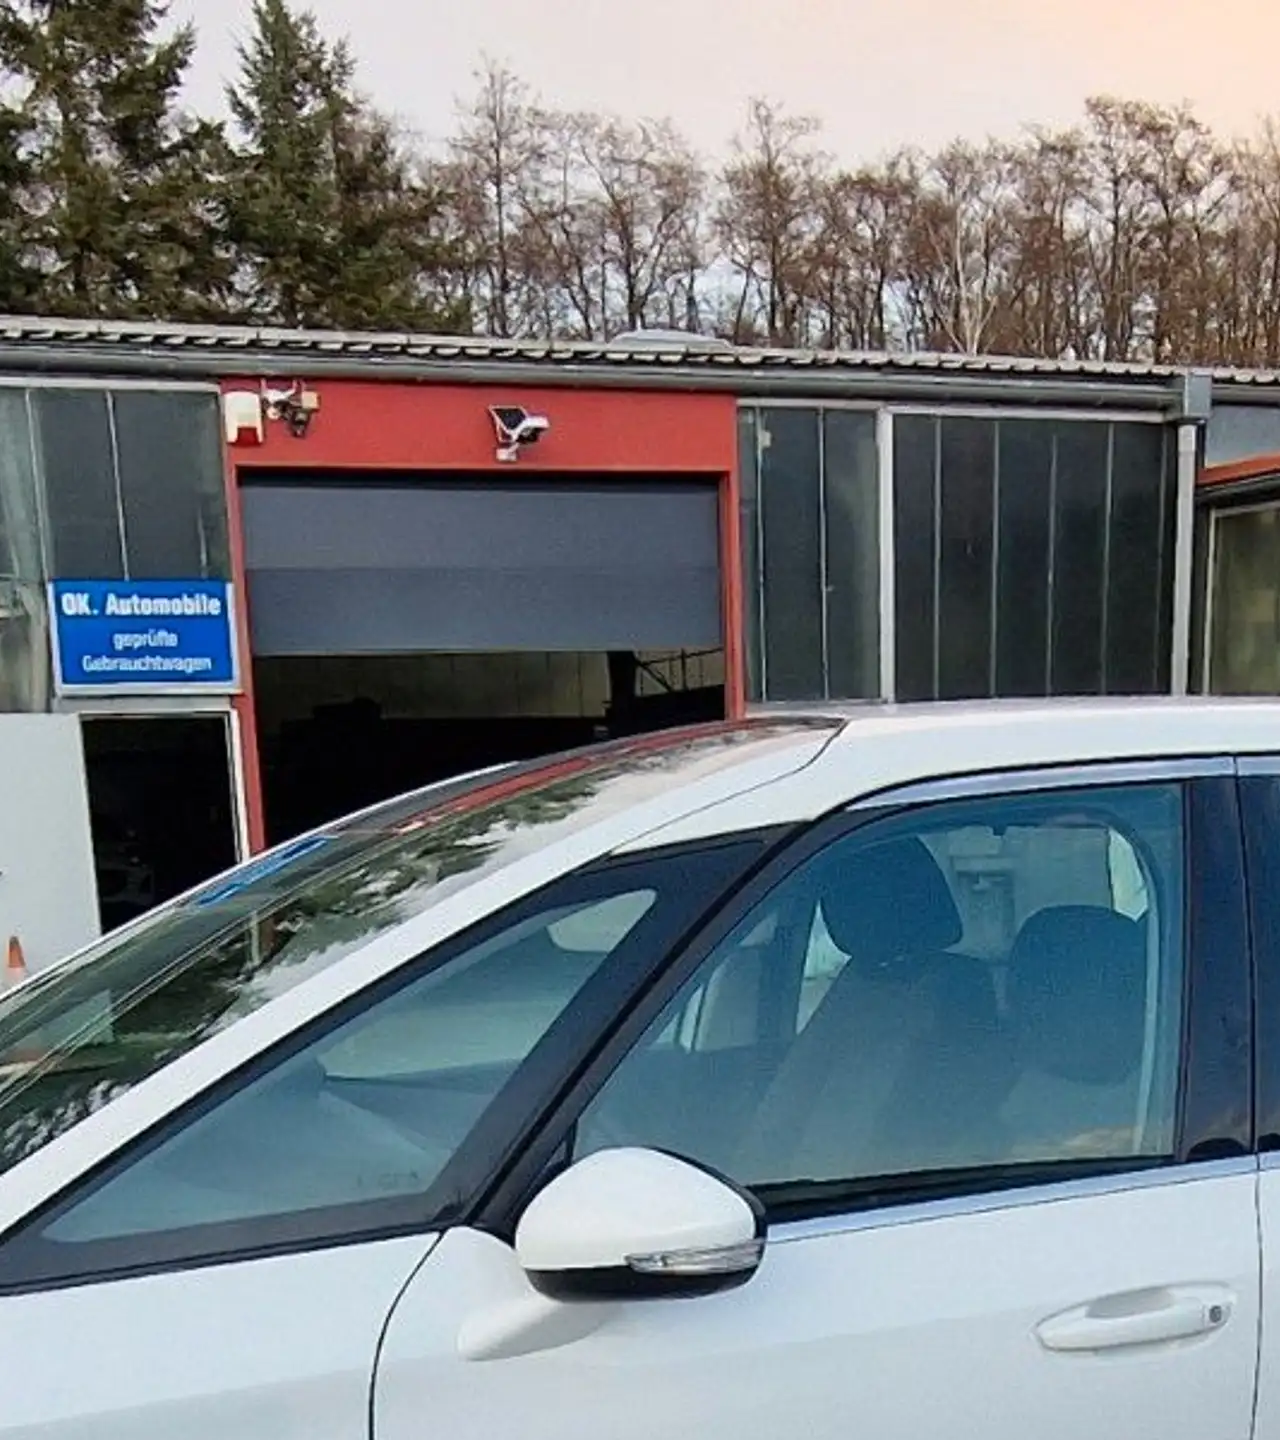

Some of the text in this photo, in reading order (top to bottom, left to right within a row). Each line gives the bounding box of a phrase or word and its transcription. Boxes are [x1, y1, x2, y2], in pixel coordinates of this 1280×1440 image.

[105, 593, 221, 616] Automobile
[113, 629, 179, 651] geprüfte
[82, 655, 212, 674] Gebrauchtwagen
